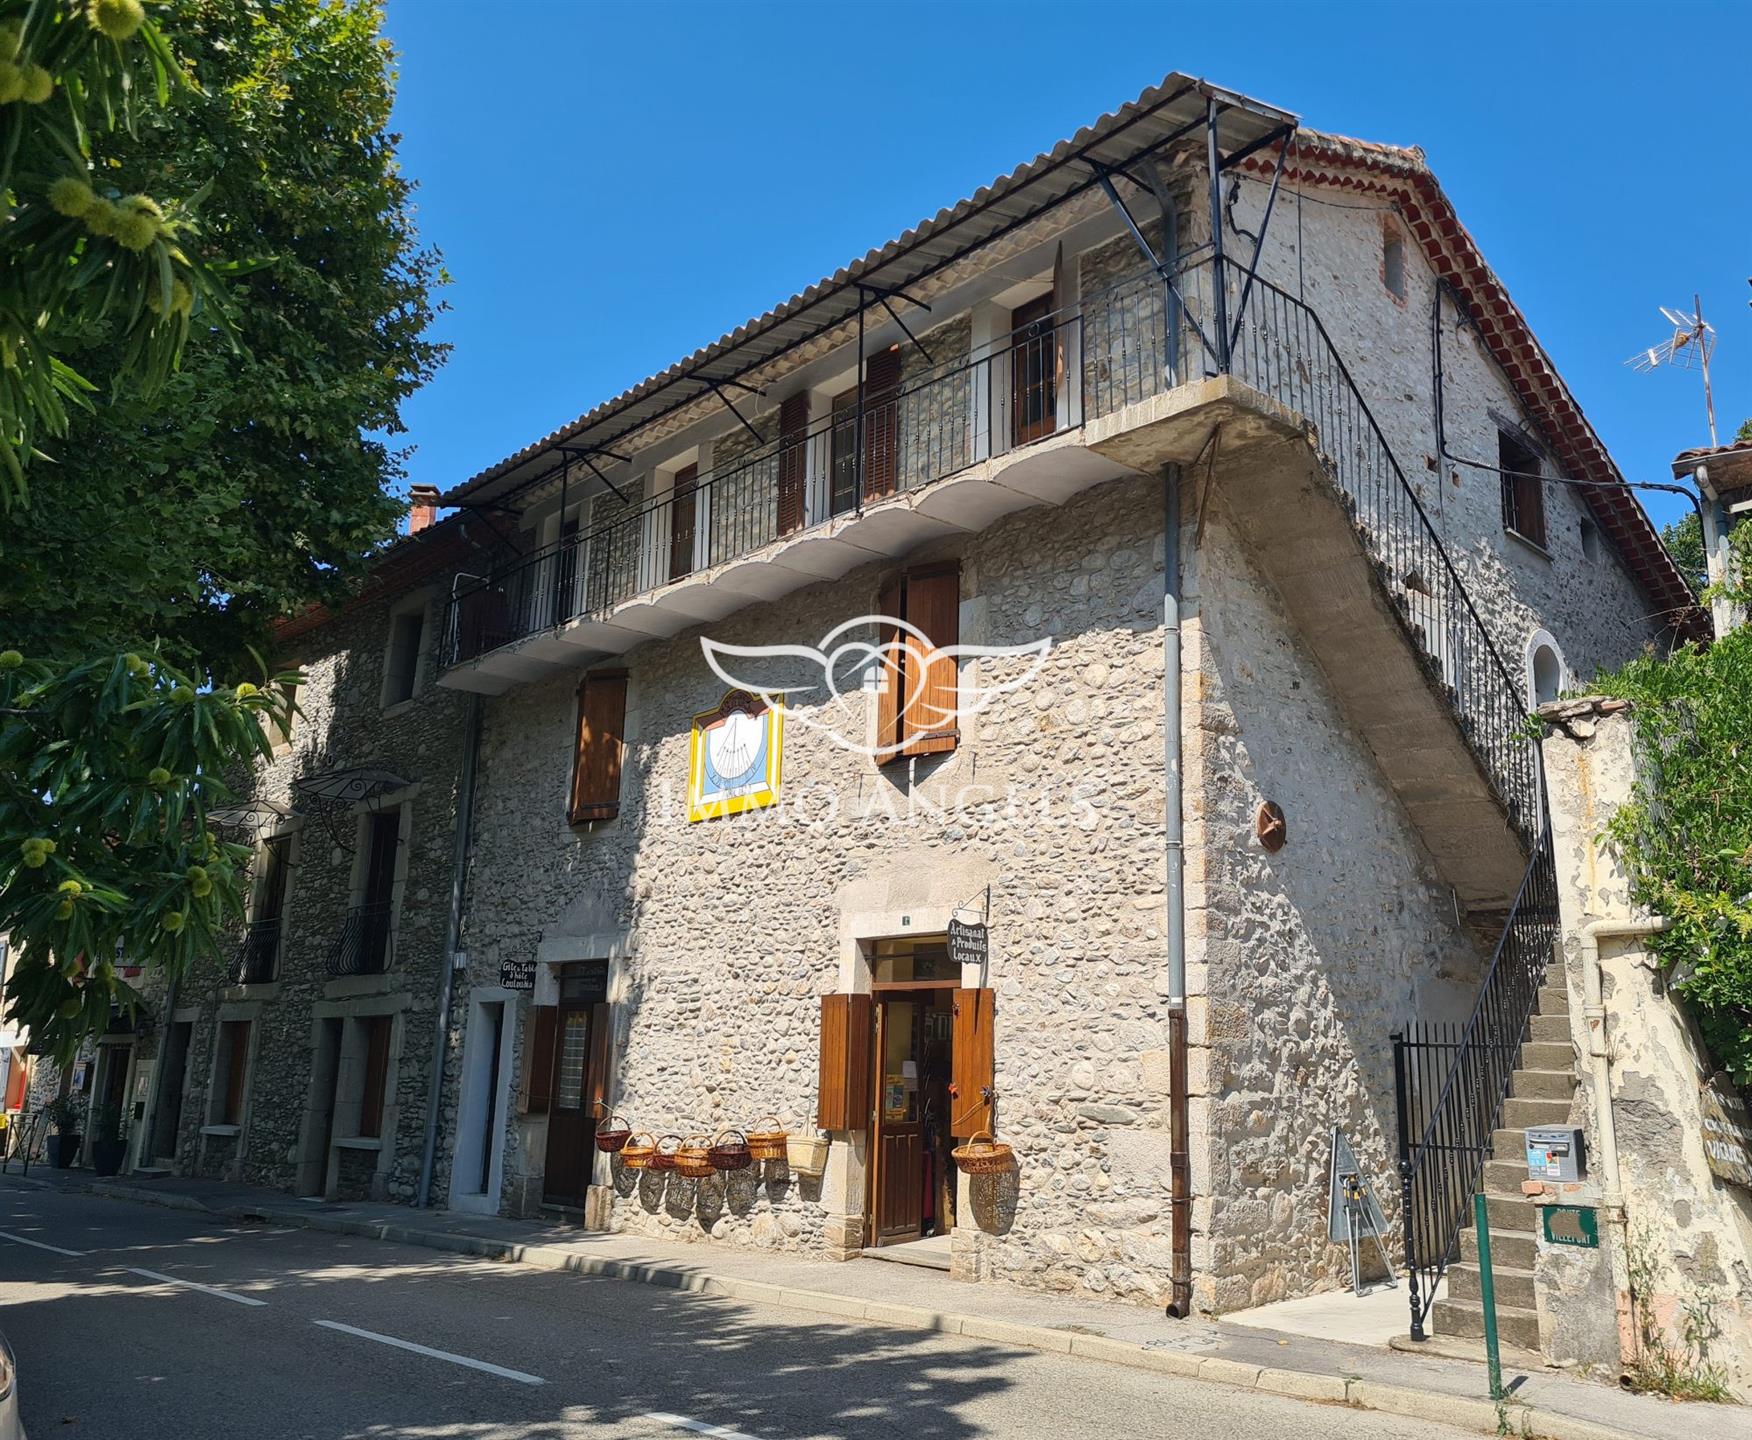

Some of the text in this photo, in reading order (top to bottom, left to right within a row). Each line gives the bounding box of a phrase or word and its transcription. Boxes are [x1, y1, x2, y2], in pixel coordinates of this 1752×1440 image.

[950, 921, 985, 939] Artisanat
[956, 936, 988, 953] Produits
[953, 947, 982, 963] Locaux
